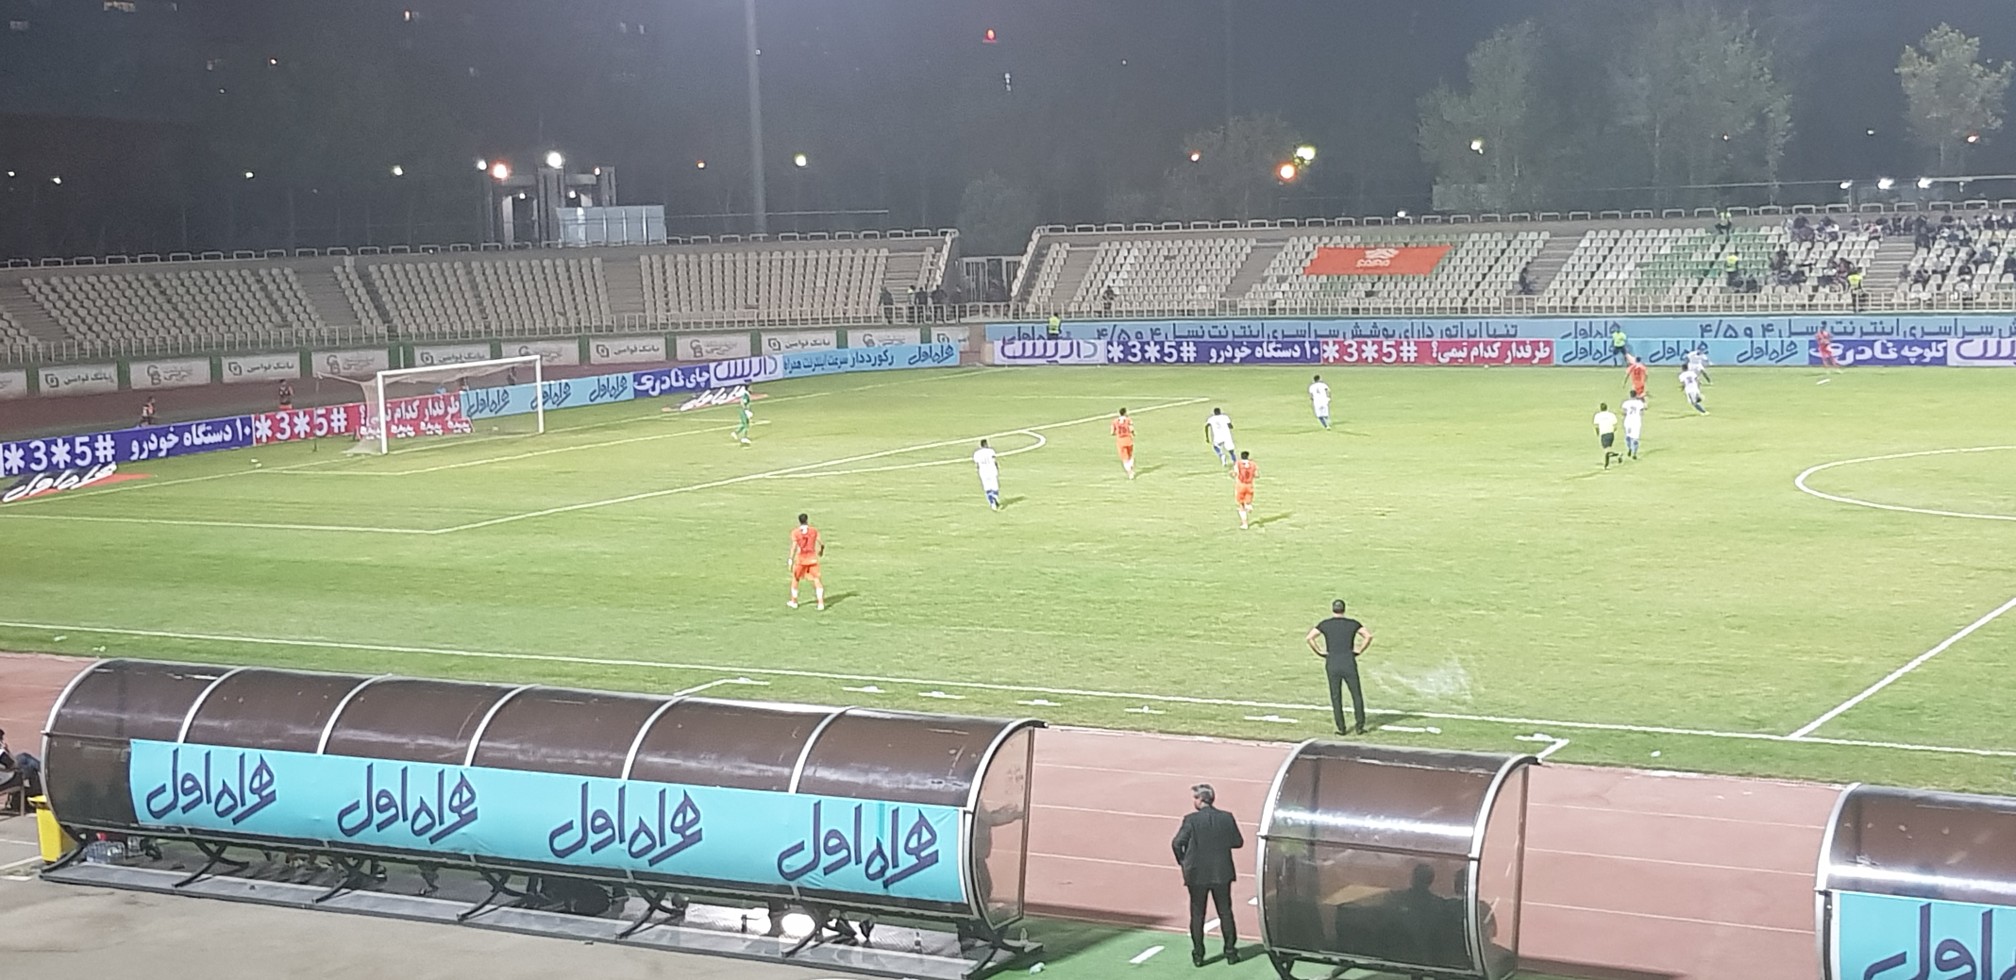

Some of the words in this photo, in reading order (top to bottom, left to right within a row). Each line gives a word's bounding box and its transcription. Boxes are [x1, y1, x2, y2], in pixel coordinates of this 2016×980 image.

[1208, 341, 1252, 364] خودرو
[1254, 341, 1301, 360] دستگاه
[1469, 340, 1501, 363] کدام
[1504, 340, 1550, 364] طرفدار
[129, 425, 180, 462] خودرو
[183, 422, 233, 447] دستگاه
[146, 748, 212, 819] اول
[214, 753, 278, 825] همراه
[338, 762, 408, 837] اول
[411, 768, 479, 844] همراه
[549, 781, 626, 858] اول
[628, 788, 703, 867] همراه
[777, 799, 863, 881] اول
[864, 806, 939, 890] همراه
